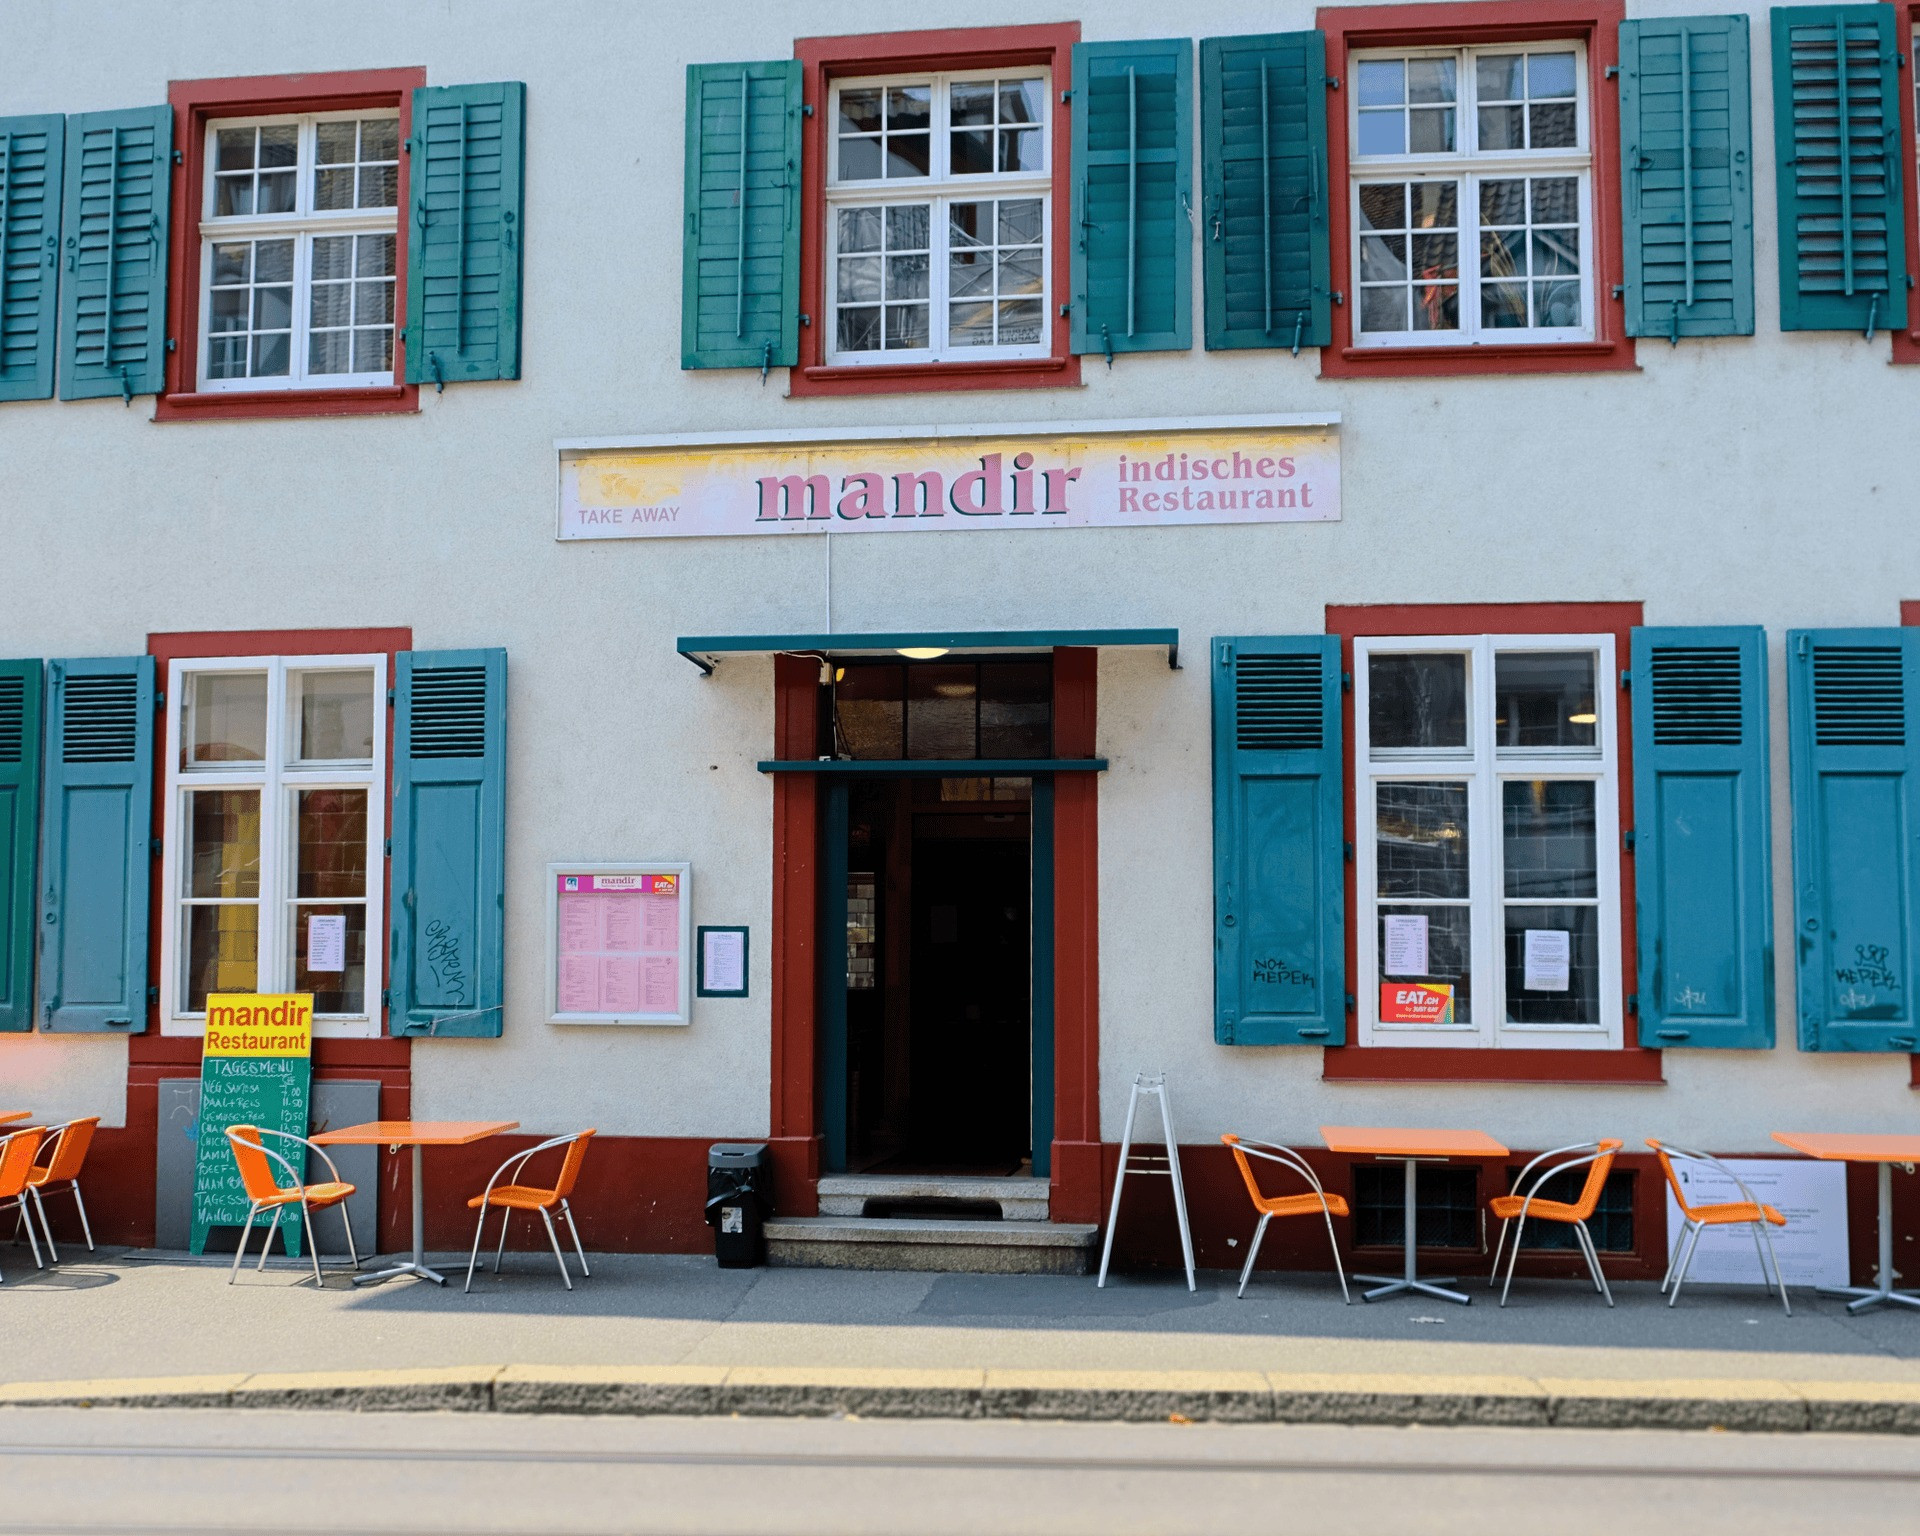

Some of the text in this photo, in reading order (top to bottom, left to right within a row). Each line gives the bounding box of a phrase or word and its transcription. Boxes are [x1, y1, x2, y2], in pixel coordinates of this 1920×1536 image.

[1118, 451, 1297, 482] indisches
[755, 452, 1083, 522] mandir
[1118, 482, 1314, 513] Restaurant
[578, 506, 681, 525] TAKE AWAY
[601, 876, 635, 884] mandir
[208, 1000, 308, 1026] mandir
[207, 1031, 306, 1049] Restaurant
[204, 1080, 222, 1094] VEG
